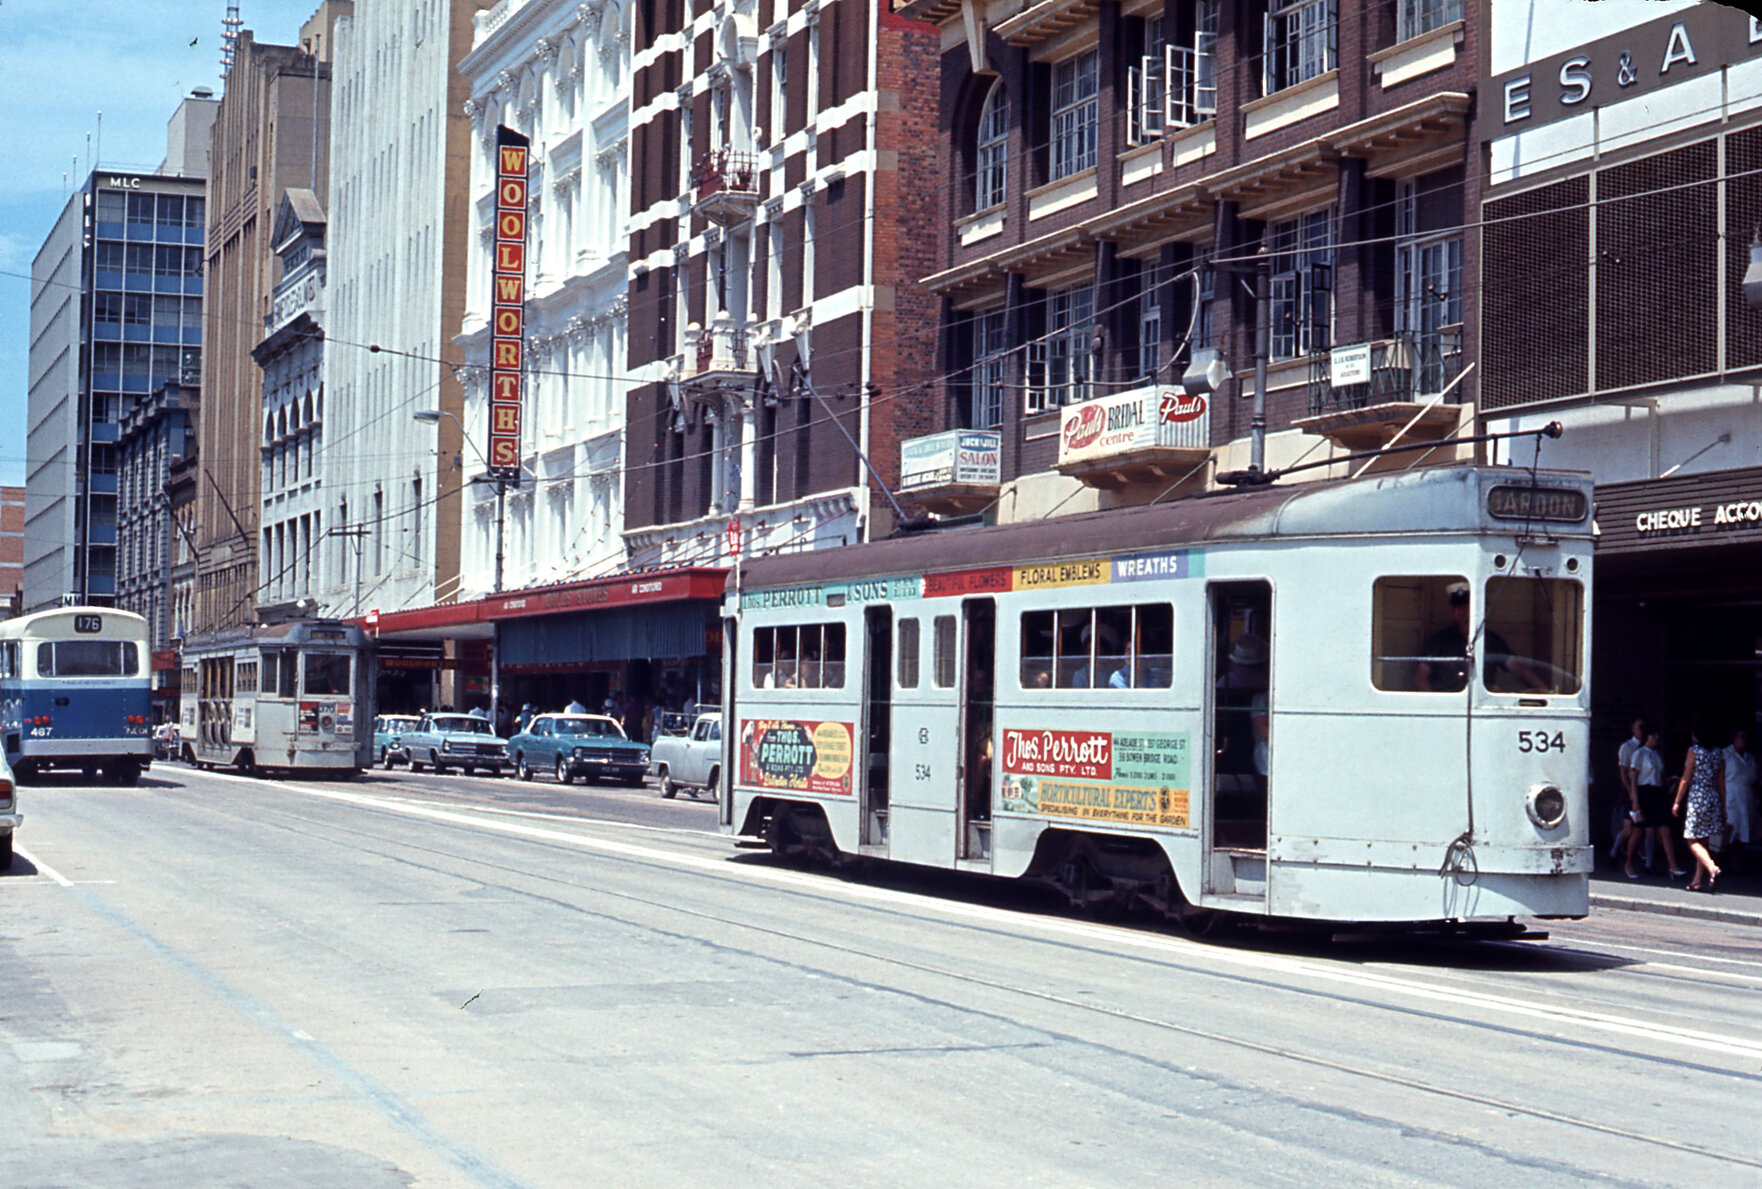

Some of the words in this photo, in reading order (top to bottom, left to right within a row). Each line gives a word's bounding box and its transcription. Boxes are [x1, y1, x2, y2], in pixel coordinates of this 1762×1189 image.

[110, 177, 140, 188] MLC
[495, 150, 525, 463] WOOLWORTHS
[1108, 400, 1145, 432] BRIDAL
[1100, 432, 1134, 447] centre
[960, 452, 997, 466] SALON
[1636, 507, 1702, 532] CHEQUE
[1714, 501, 1762, 525] ACCO
[1020, 568, 1057, 585] FLORAL
[1060, 563, 1101, 582] EMBLEMS
[1116, 556, 1178, 577] WREATHS
[762, 586, 822, 608] PERROTT
[854, 580, 888, 600] SONS
[78, 617, 100, 630] 176
[1006, 730, 1041, 768] Thos.
[1042, 731, 1109, 764] Perrott
[1518, 731, 1567, 753] 534
[760, 743, 813, 765] PERROTT
[915, 763, 931, 780] 534
[1021, 762, 1034, 772] AND
[1036, 763, 1055, 773] SONS
[1059, 764, 1076, 774] PTY.
[1081, 766, 1097, 776] LTD.
[1040, 782, 1111, 808] HORTICULTURAL
[1113, 788, 1157, 811] EXPERTS
[1082, 807, 1089, 816] IN
[1092, 808, 1129, 820] EVERYTHING
[1131, 812, 1144, 821] FOR
[1145, 813, 1157, 823] THE
[1159, 814, 1186, 826] GARDEN
